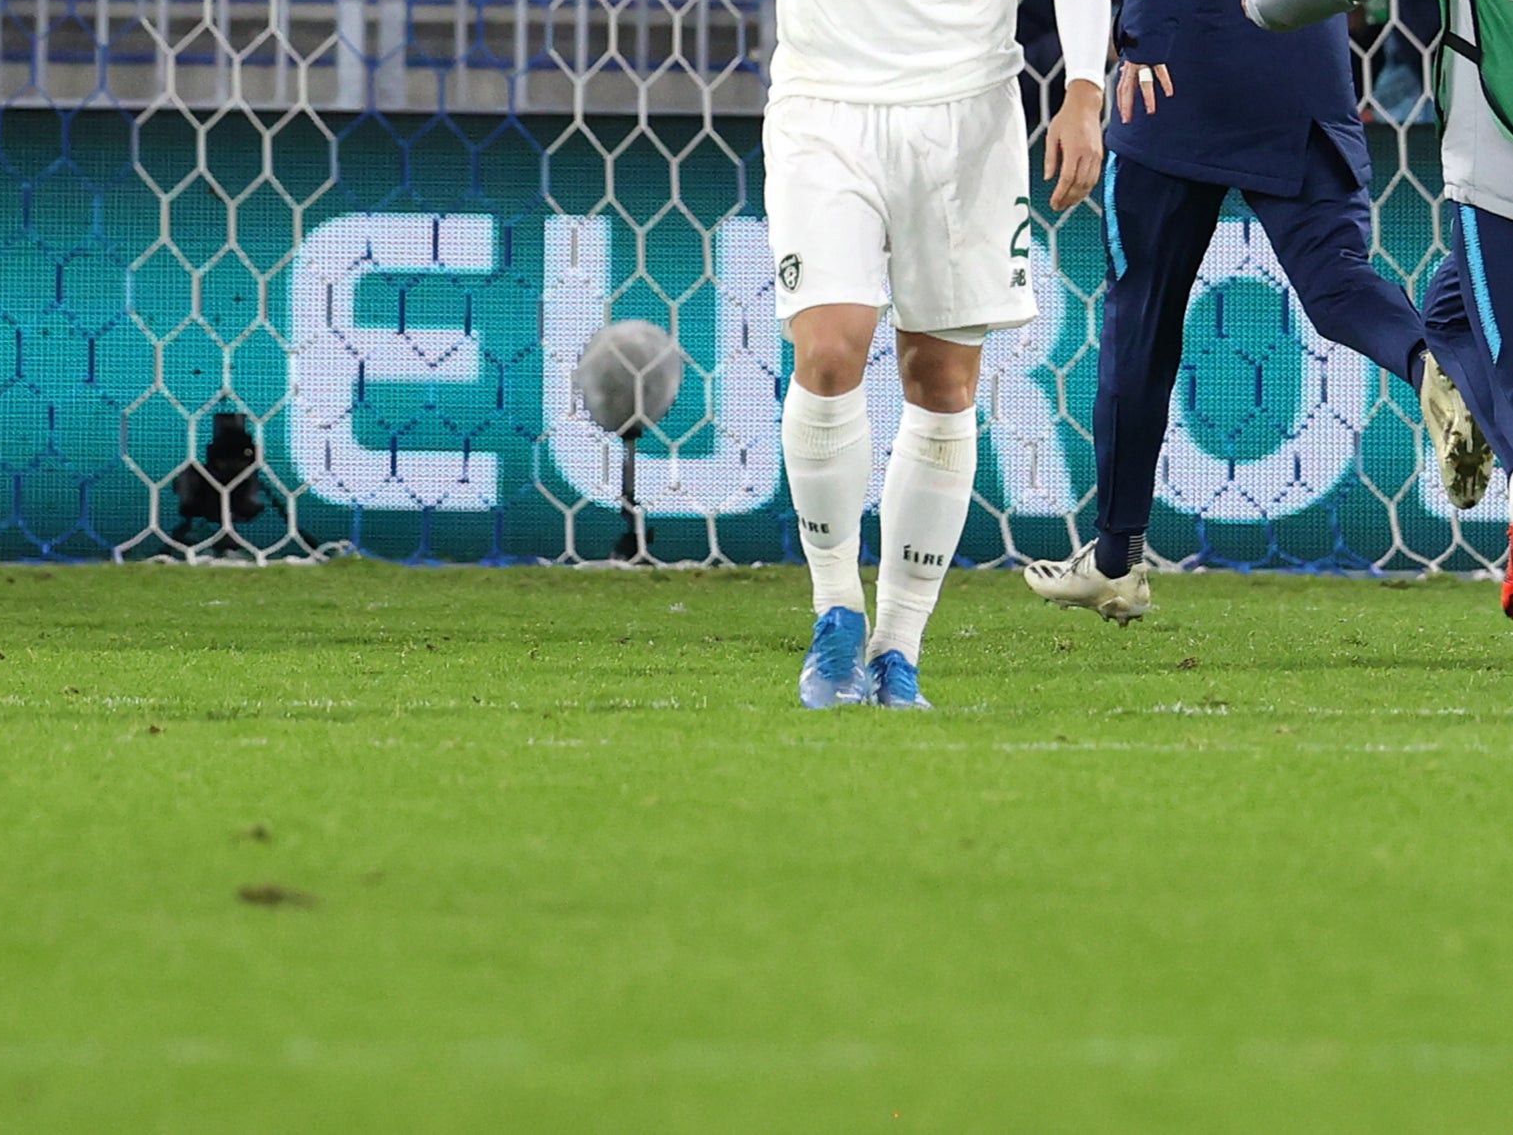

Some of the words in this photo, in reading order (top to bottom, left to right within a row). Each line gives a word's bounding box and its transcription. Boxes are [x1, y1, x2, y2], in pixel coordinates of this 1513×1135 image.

[1010, 196, 1030, 258] 2
[288, 211, 1370, 522] EURO
[801, 517, 830, 534] IRE
[903, 544, 944, 566] ÉIRE
